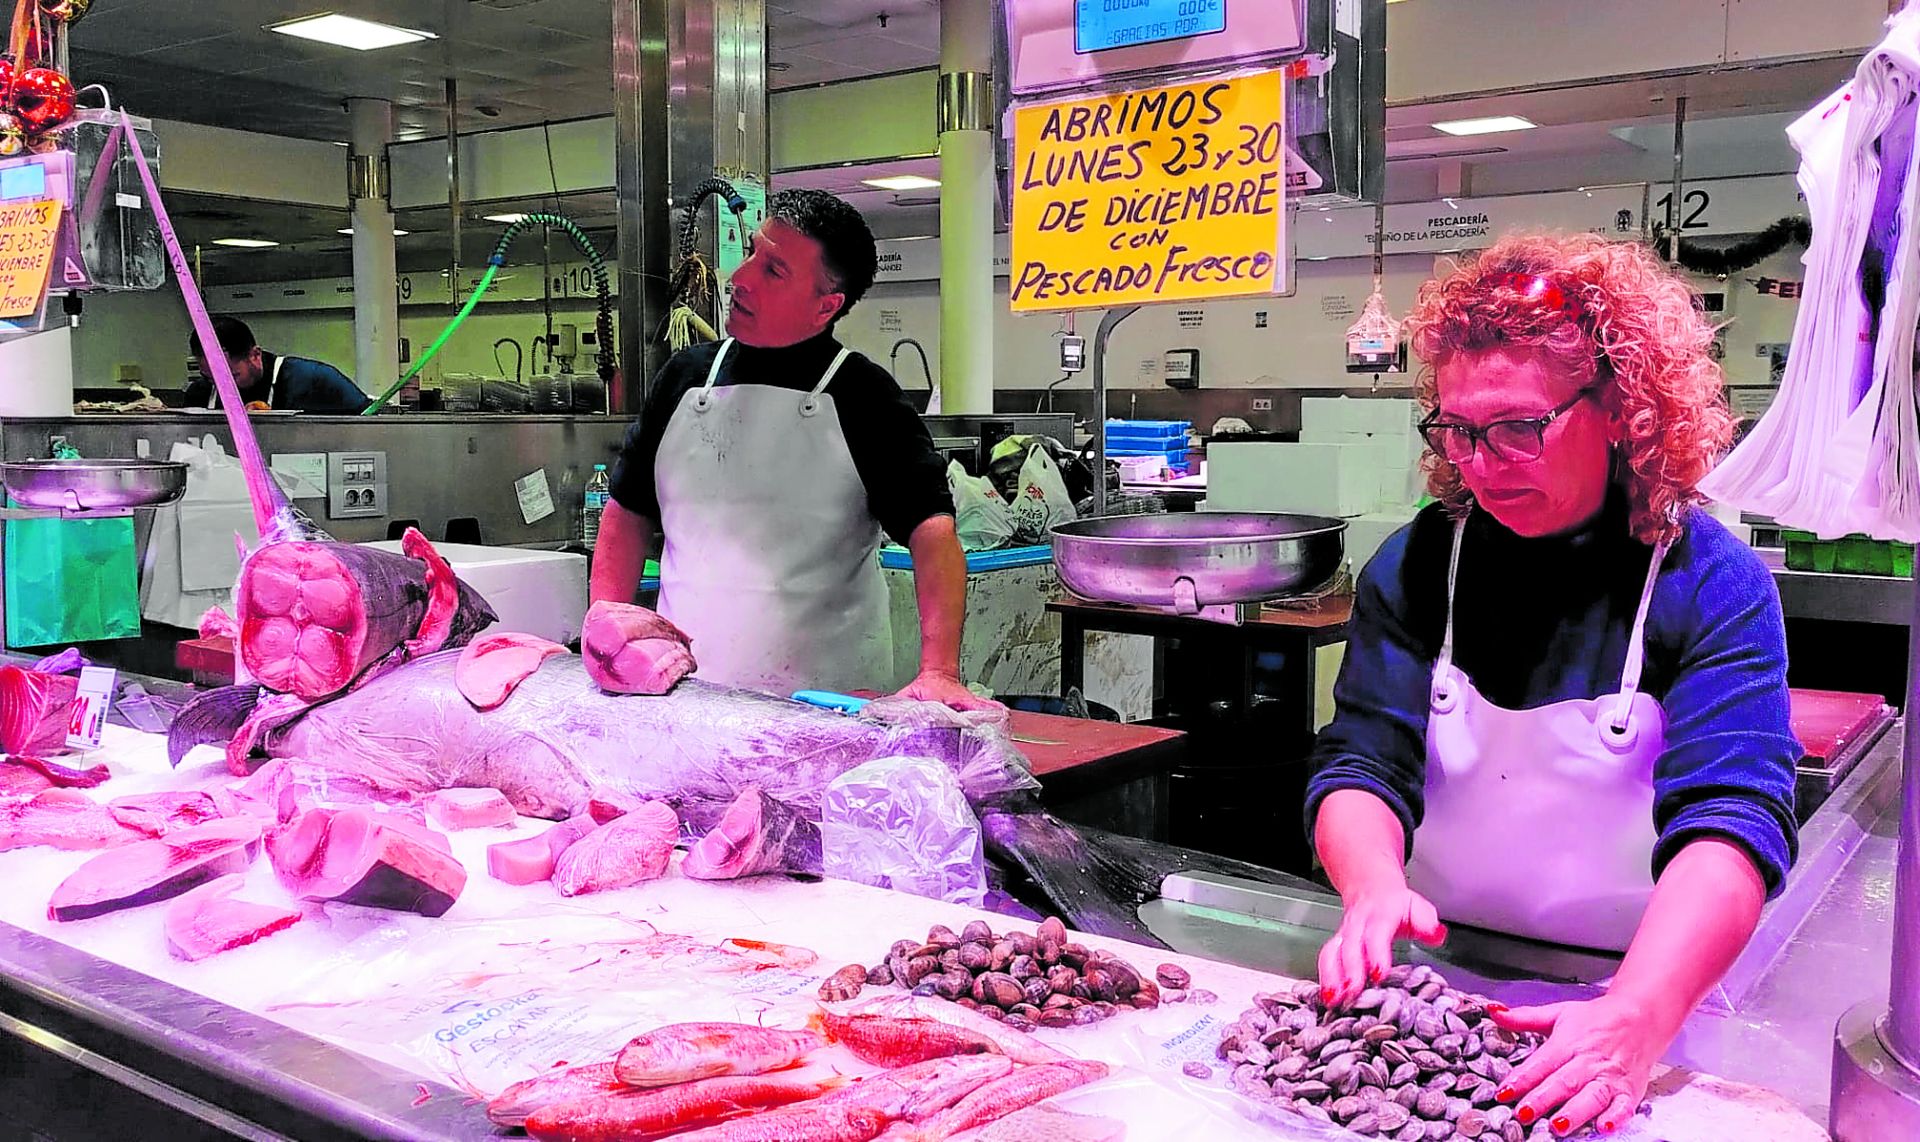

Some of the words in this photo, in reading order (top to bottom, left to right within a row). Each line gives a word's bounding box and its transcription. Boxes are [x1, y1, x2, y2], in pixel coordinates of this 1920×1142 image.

[1040, 83, 1230, 142] ABRIMOS
[1021, 140, 1151, 191] LUNES
[1161, 133, 1210, 176] 23
[1238, 121, 1282, 166] 30
[1038, 198, 1088, 232] DE
[1104, 171, 1277, 227] DICIEMBRE
[1428, 212, 1489, 227] PESCADERÍA
[1656, 190, 1710, 229] 12
[877, 252, 902, 262] ADERÍA
[1011, 261, 1151, 301] PESCADO
[1154, 245, 1274, 294] Fresco
[401, 277, 411, 299] 9
[569, 267, 593, 292] 10
